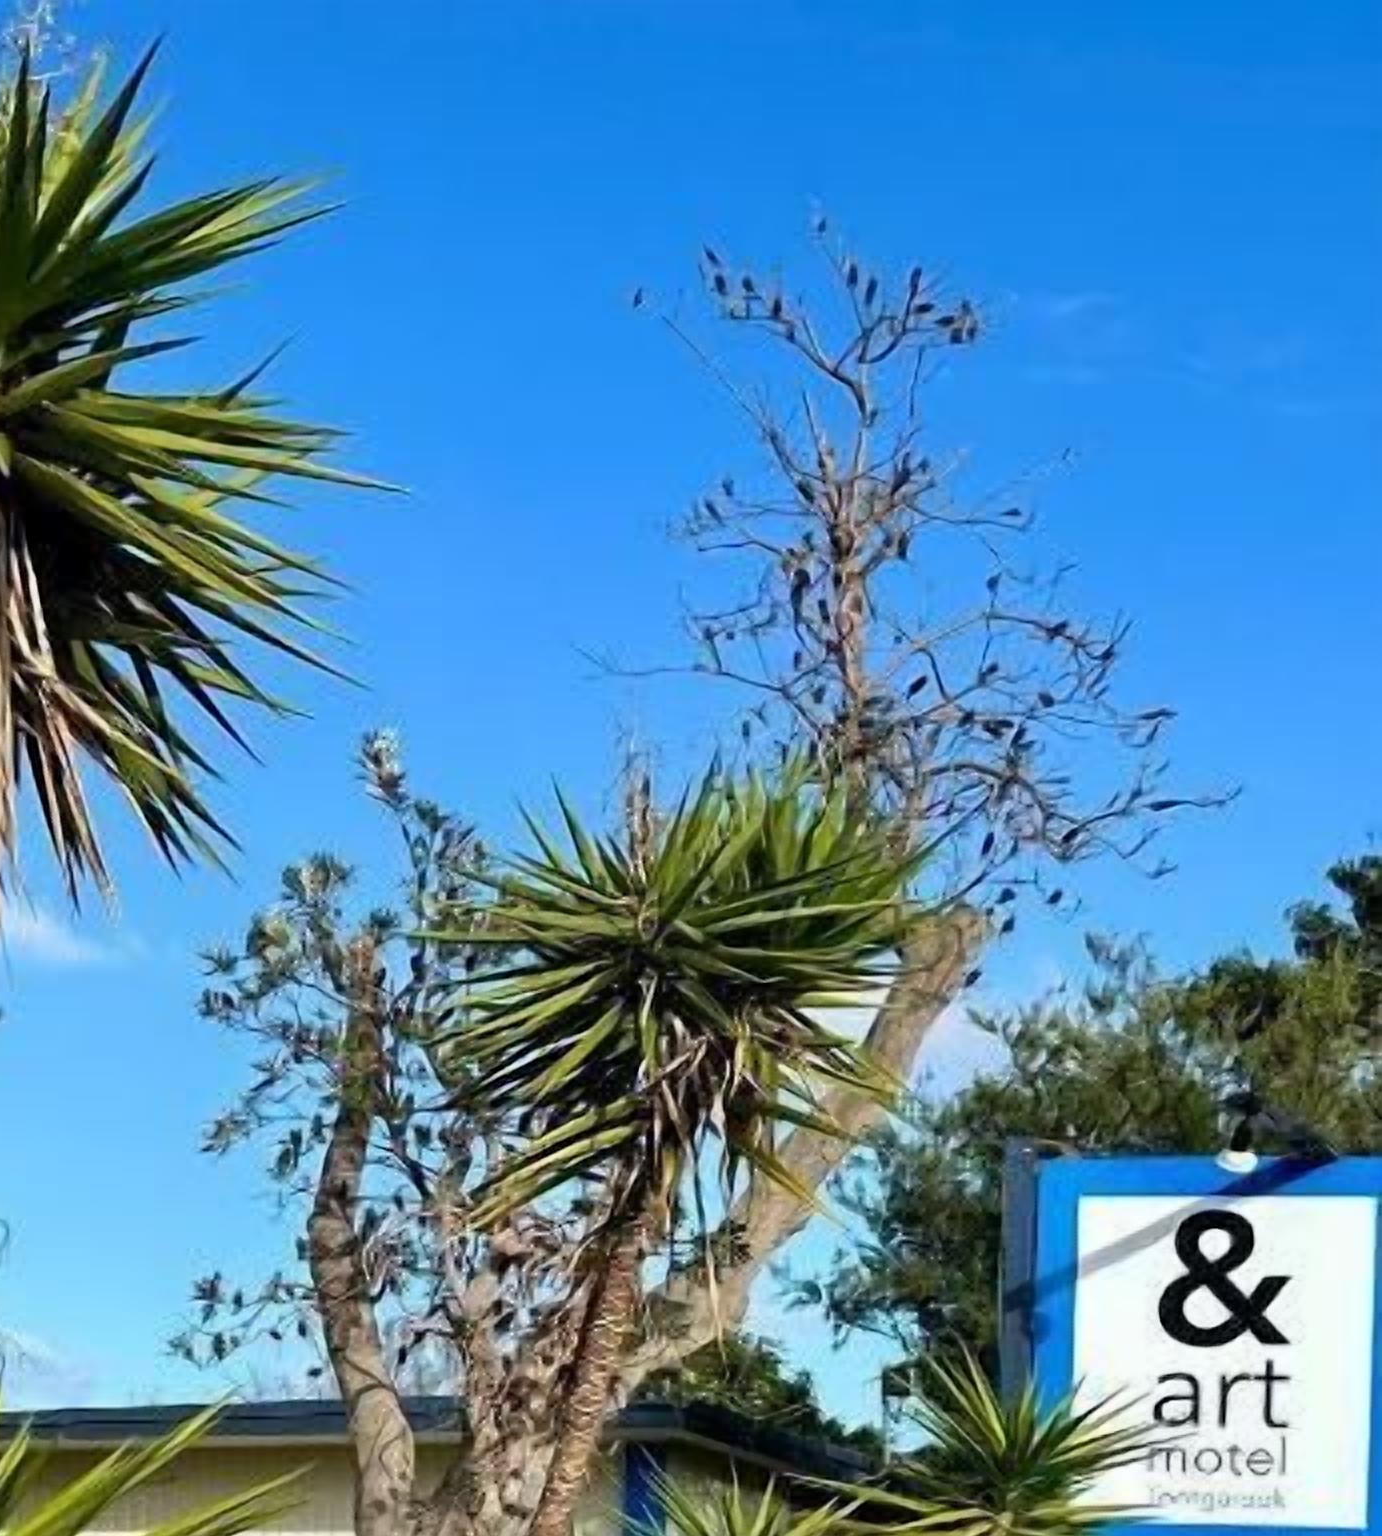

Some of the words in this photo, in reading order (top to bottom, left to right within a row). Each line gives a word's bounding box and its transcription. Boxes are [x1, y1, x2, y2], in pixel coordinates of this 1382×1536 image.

[1158, 1209, 1292, 1347] &
[1153, 1358, 1291, 1428] art
[1149, 1435, 1286, 1476] motel
